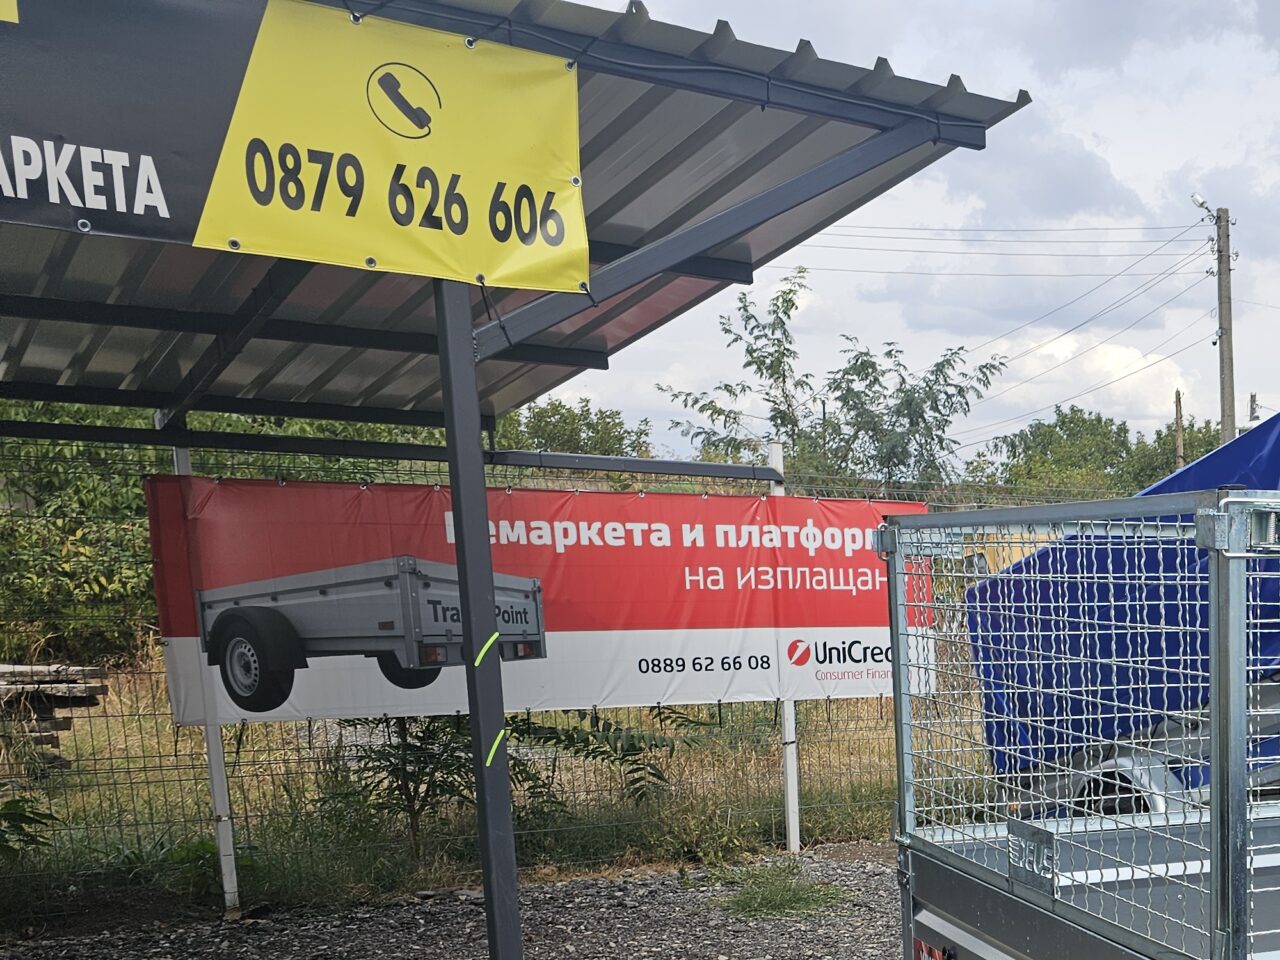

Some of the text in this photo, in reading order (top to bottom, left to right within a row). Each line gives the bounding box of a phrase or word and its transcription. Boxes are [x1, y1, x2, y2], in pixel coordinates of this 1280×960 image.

[245, 138, 566, 247] 0879 626 606
[682, 523, 704, 547] и
[715, 518, 876, 557] платфор
[685, 566, 893, 595] на изплащан
[638, 655, 771, 673] 0889 62 66 08
[815, 640, 892, 664] UniCre
[815, 669, 862, 681] Consumer
